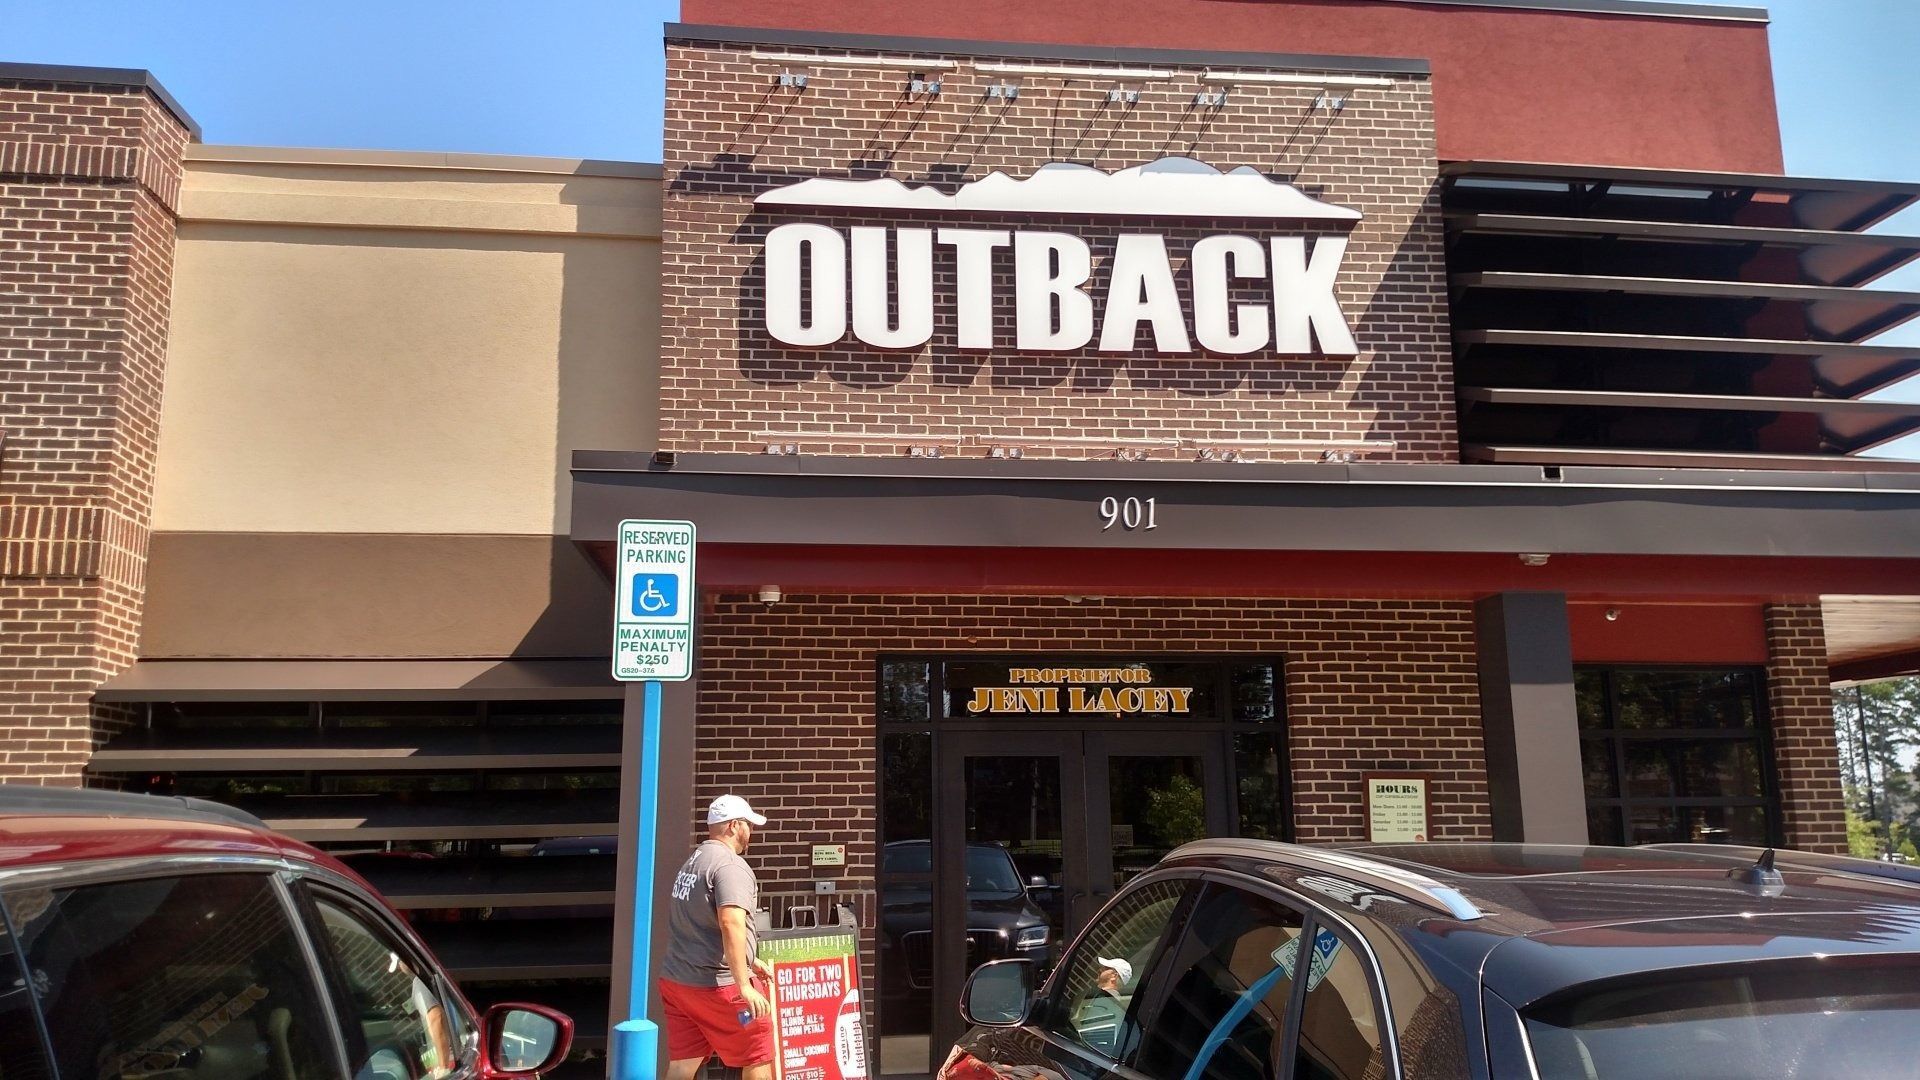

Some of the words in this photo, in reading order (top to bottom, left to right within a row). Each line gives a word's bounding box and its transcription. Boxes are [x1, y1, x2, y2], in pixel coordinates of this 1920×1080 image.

[764, 222, 1360, 356] OUTBACK
[1100, 496, 1158, 530] 901
[624, 530, 690, 545] RESERVED
[627, 550, 686, 564] PARKING
[620, 628, 686, 640] MAXIMUM
[620, 642, 686, 652] PENALTY
[636, 654, 669, 666] $250
[1009, 668, 1152, 684] PROPRIETOR
[968, 688, 1060, 713] JENI
[1068, 688, 1193, 713] LACEY
[1376, 785, 1418, 793] HOURS
[778, 969, 792, 984] GO
[796, 966, 816, 983] FOR
[818, 964, 842, 980] TWO
[778, 981, 841, 1002] THURSDAYS
[780, 1007, 794, 1017] PINT
